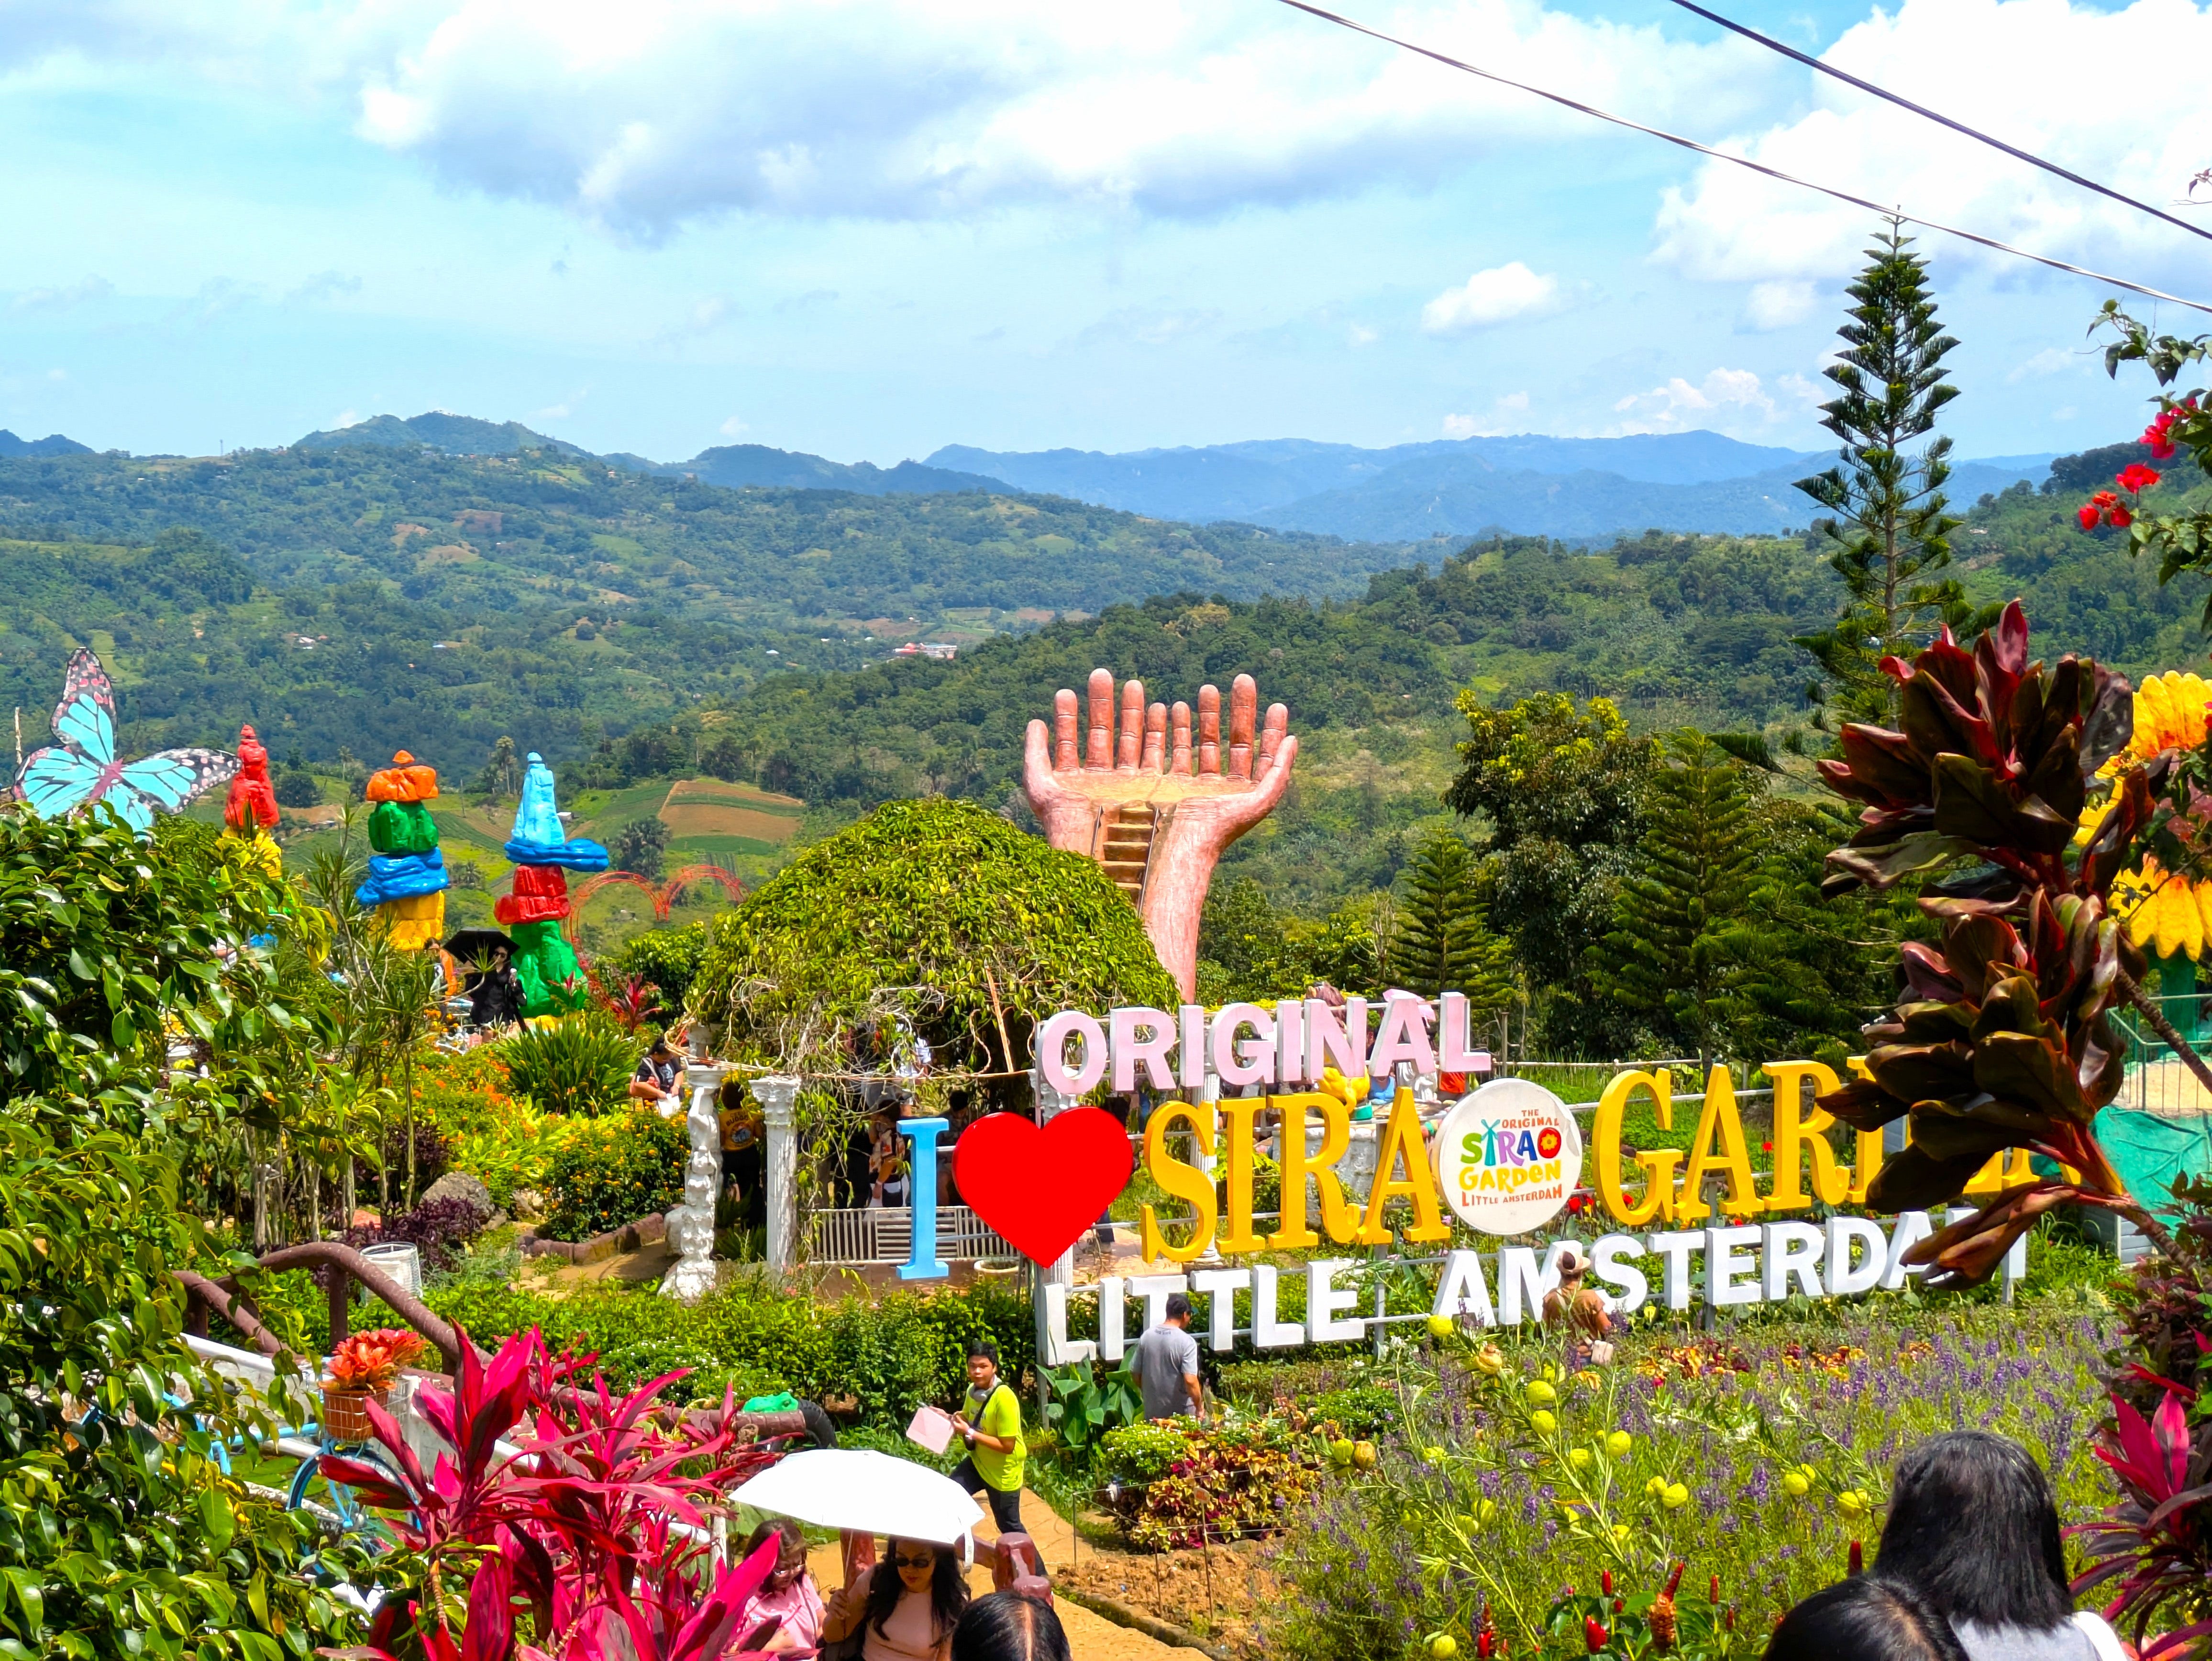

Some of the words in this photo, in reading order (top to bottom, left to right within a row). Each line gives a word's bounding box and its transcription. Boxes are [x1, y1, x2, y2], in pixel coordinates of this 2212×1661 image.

[1040, 992, 1491, 1095] ORIGINAL
[1460, 1119, 1561, 1166] SIRAO
[1502, 1117, 1559, 1129] ORIGINAL
[896, 1117, 949, 1280] I
[1461, 1191, 1498, 1207] LITTLE
[1503, 1184, 1562, 1204] AMSTERDAM
[1042, 1258, 1364, 1365] LITTLE
